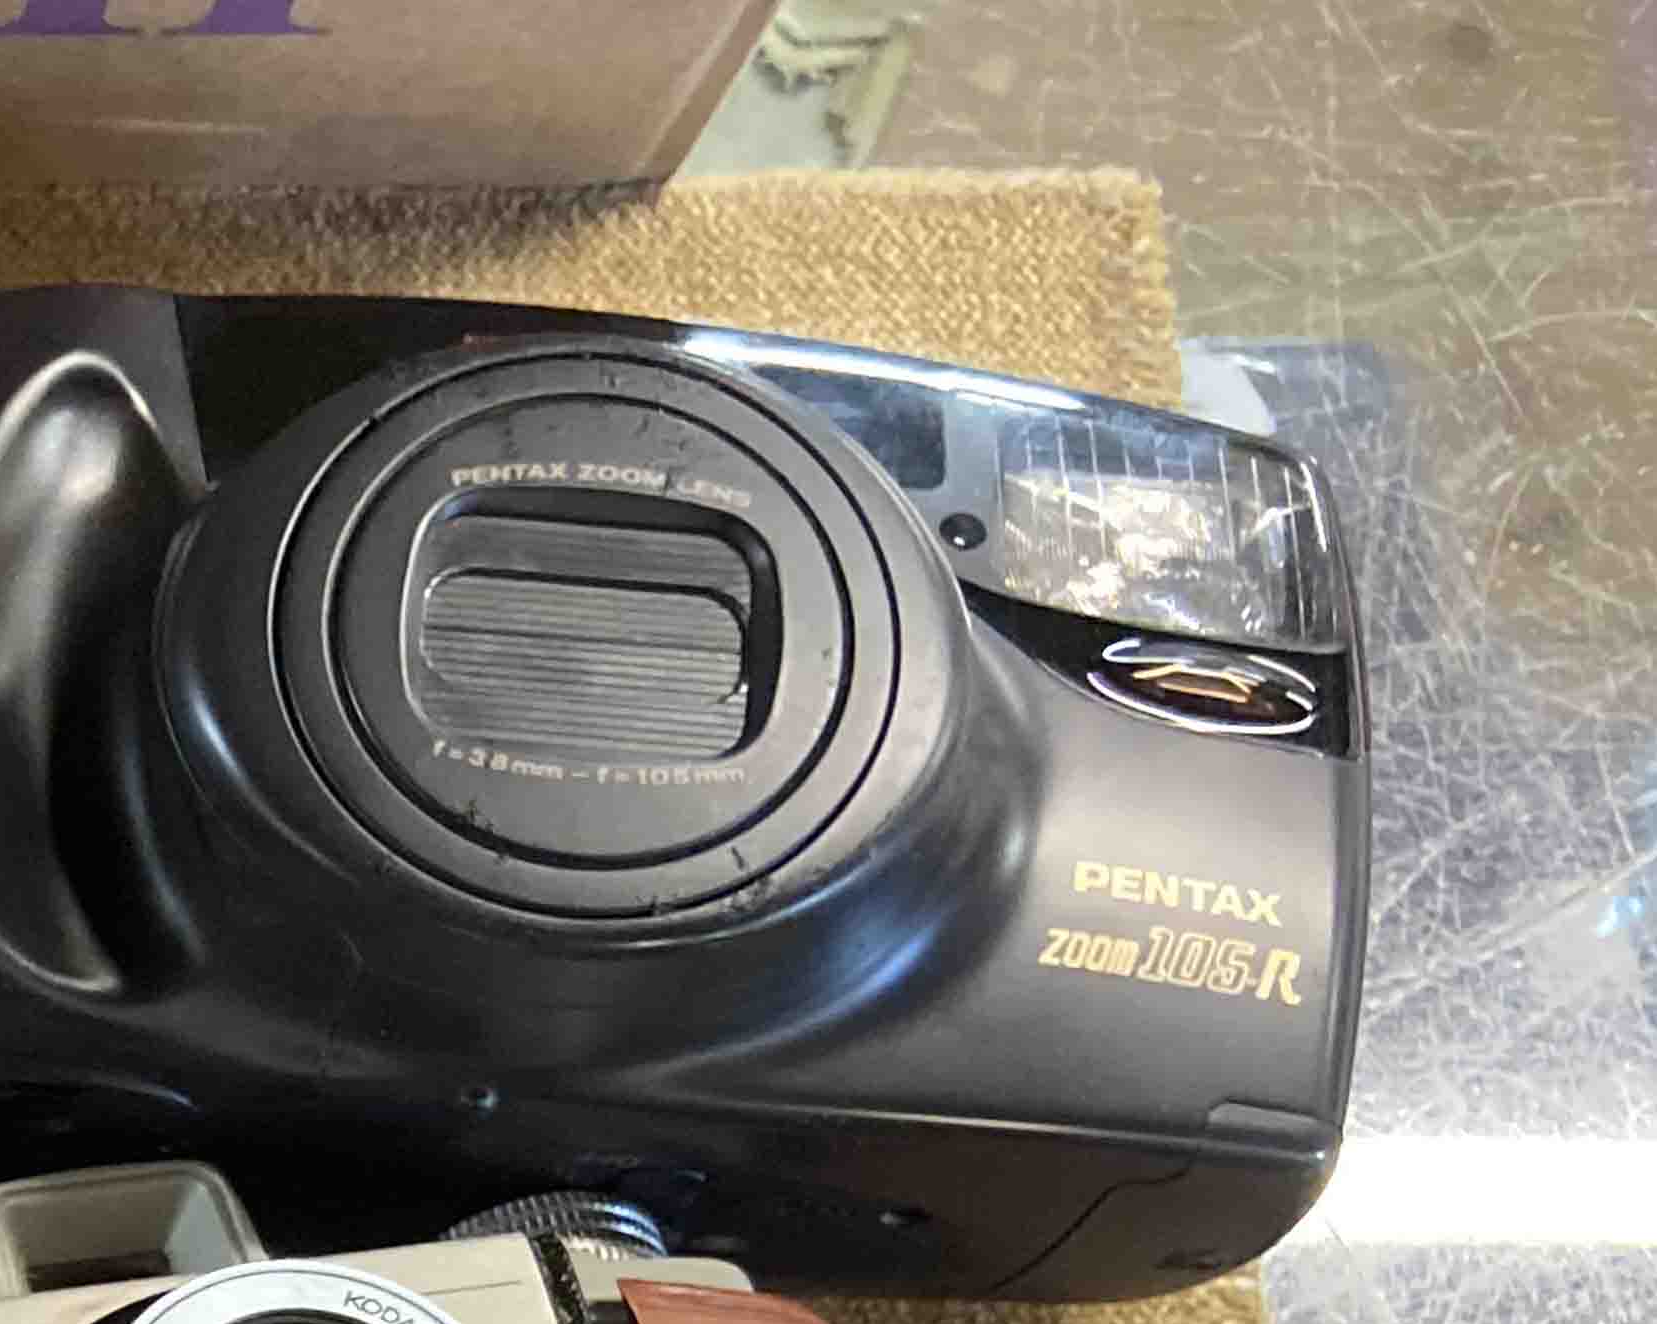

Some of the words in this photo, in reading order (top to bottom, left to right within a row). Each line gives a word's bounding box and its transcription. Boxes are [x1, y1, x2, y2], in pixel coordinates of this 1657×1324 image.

[449, 463, 567, 487] PENTAX
[576, 463, 667, 489] ZOOM
[1073, 860, 1284, 929] PENTAX
